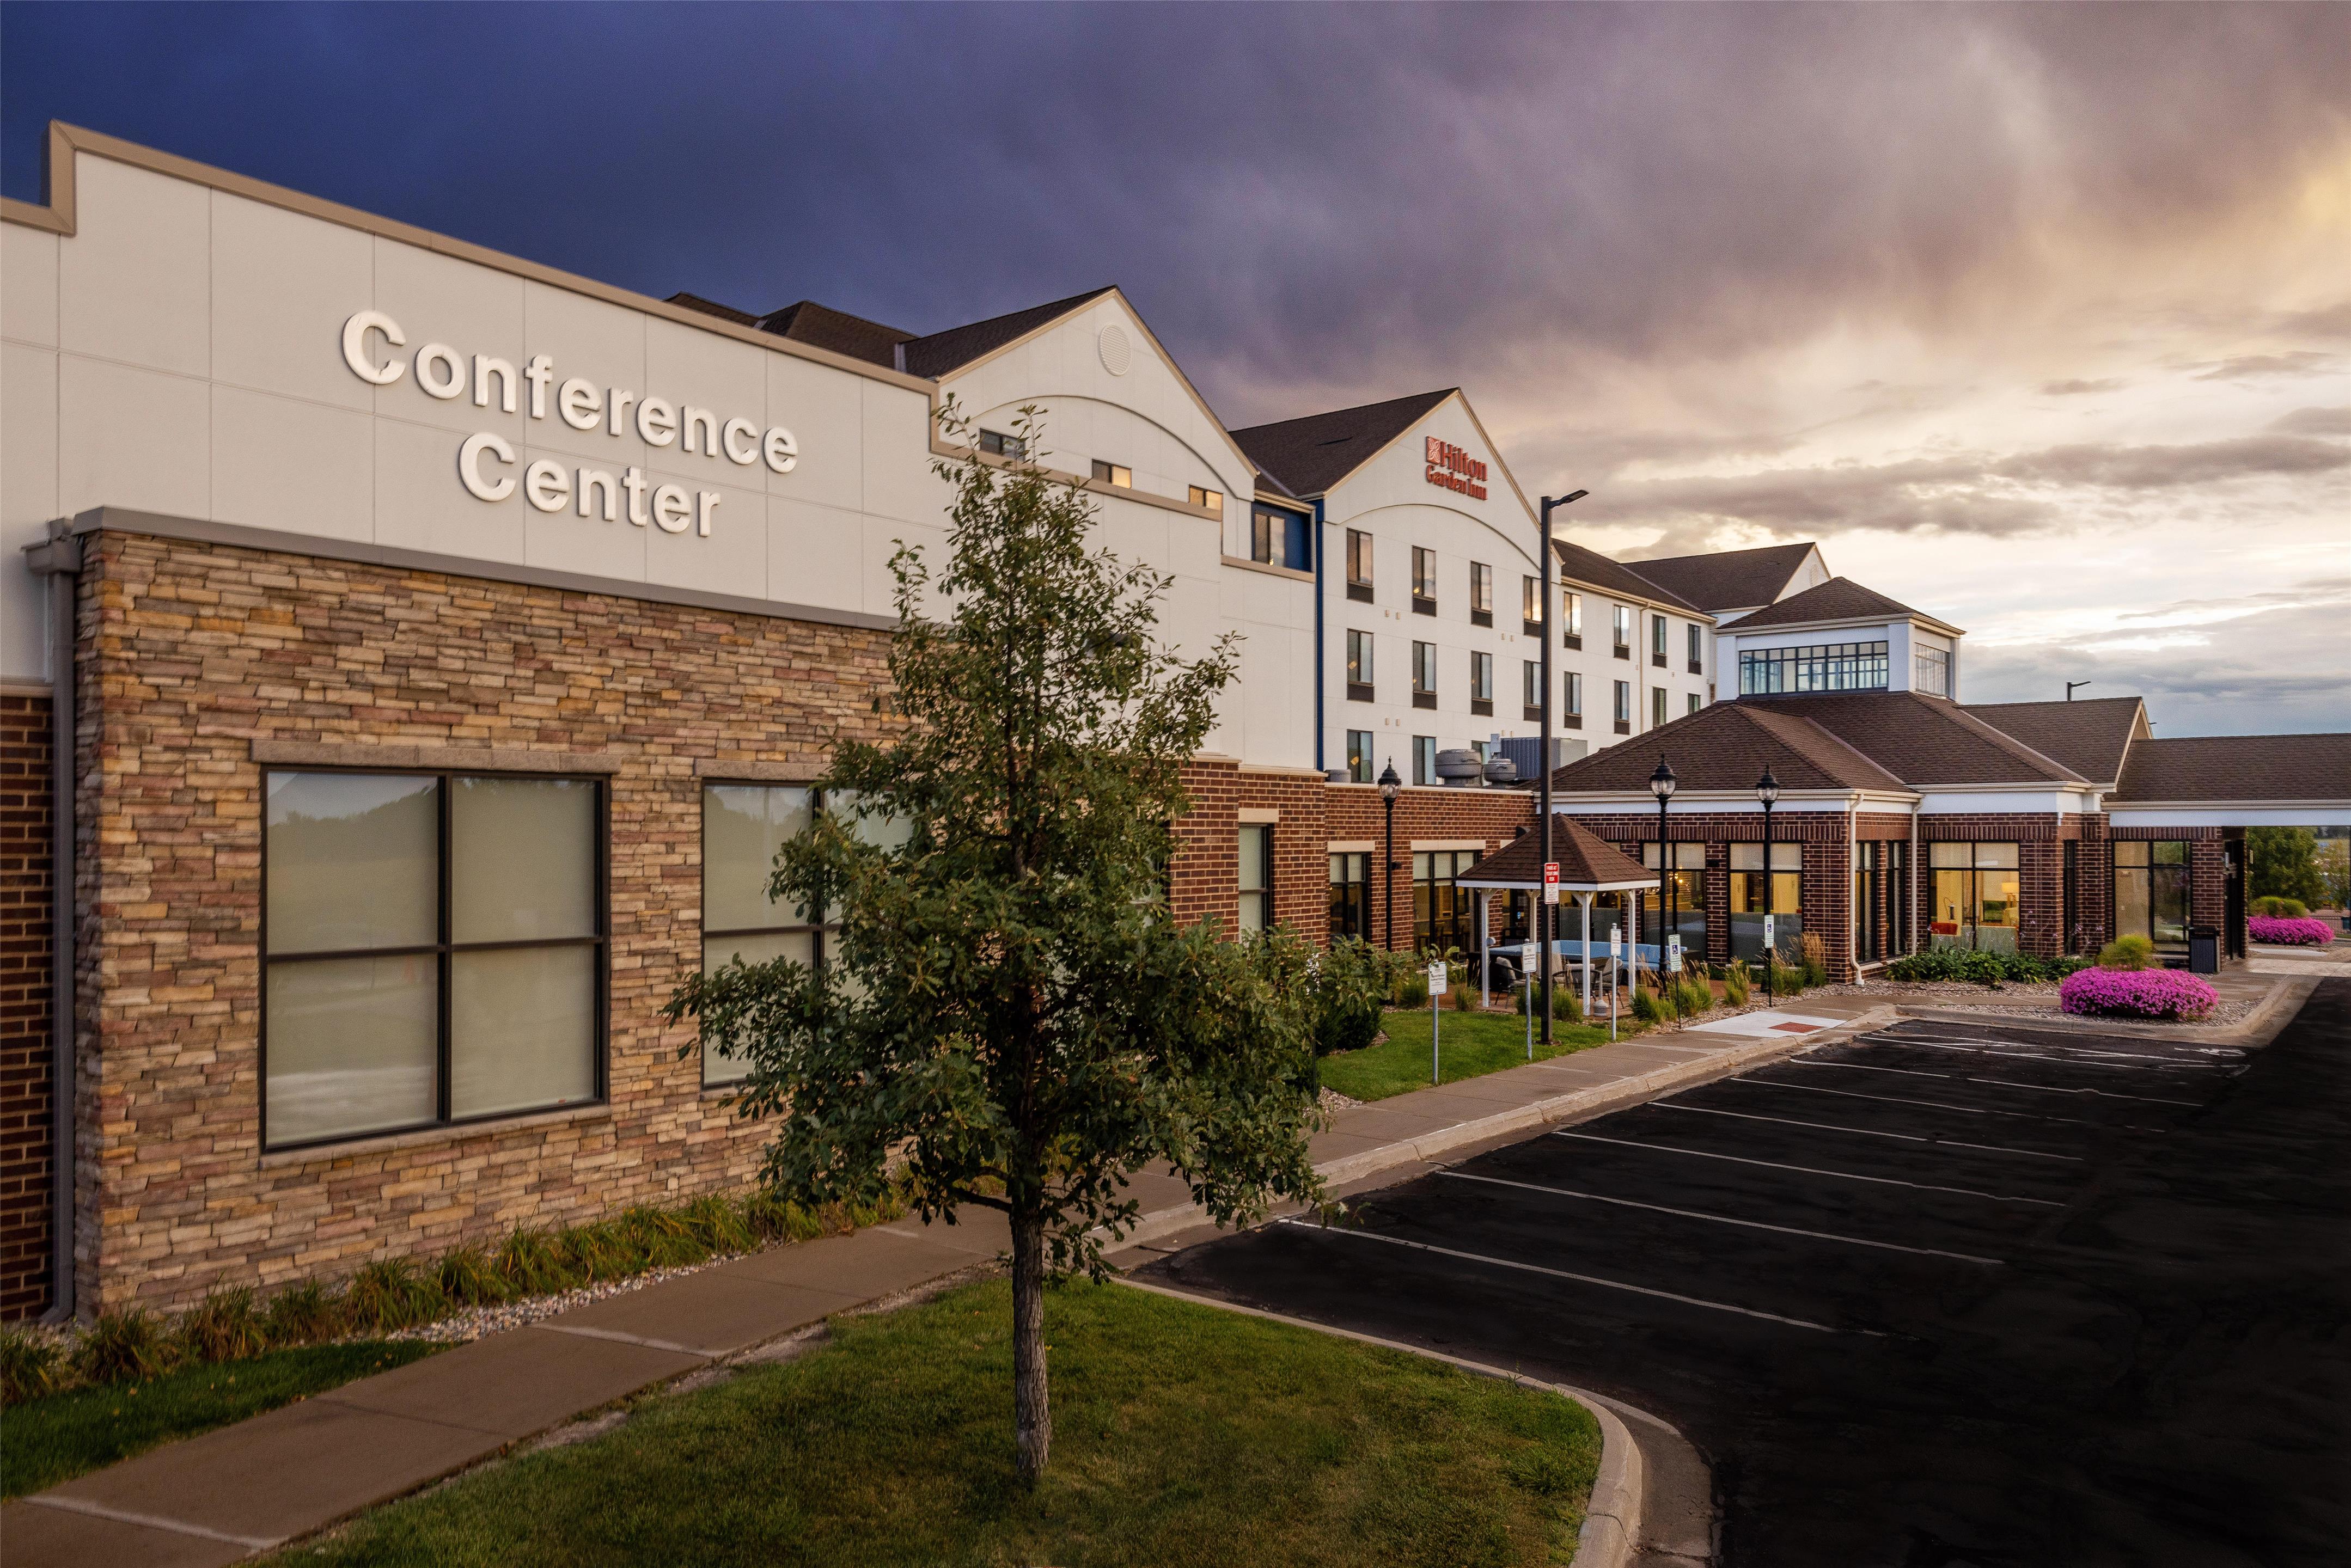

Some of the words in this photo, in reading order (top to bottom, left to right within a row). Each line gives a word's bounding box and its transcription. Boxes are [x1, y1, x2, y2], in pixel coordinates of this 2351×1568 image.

[342, 310, 799, 474] Conference
[459, 432, 720, 537] Center
[1426, 464, 1467, 494] Garden
[1467, 478, 1488, 501] Inn
[1439, 441, 1488, 481] Hilton
